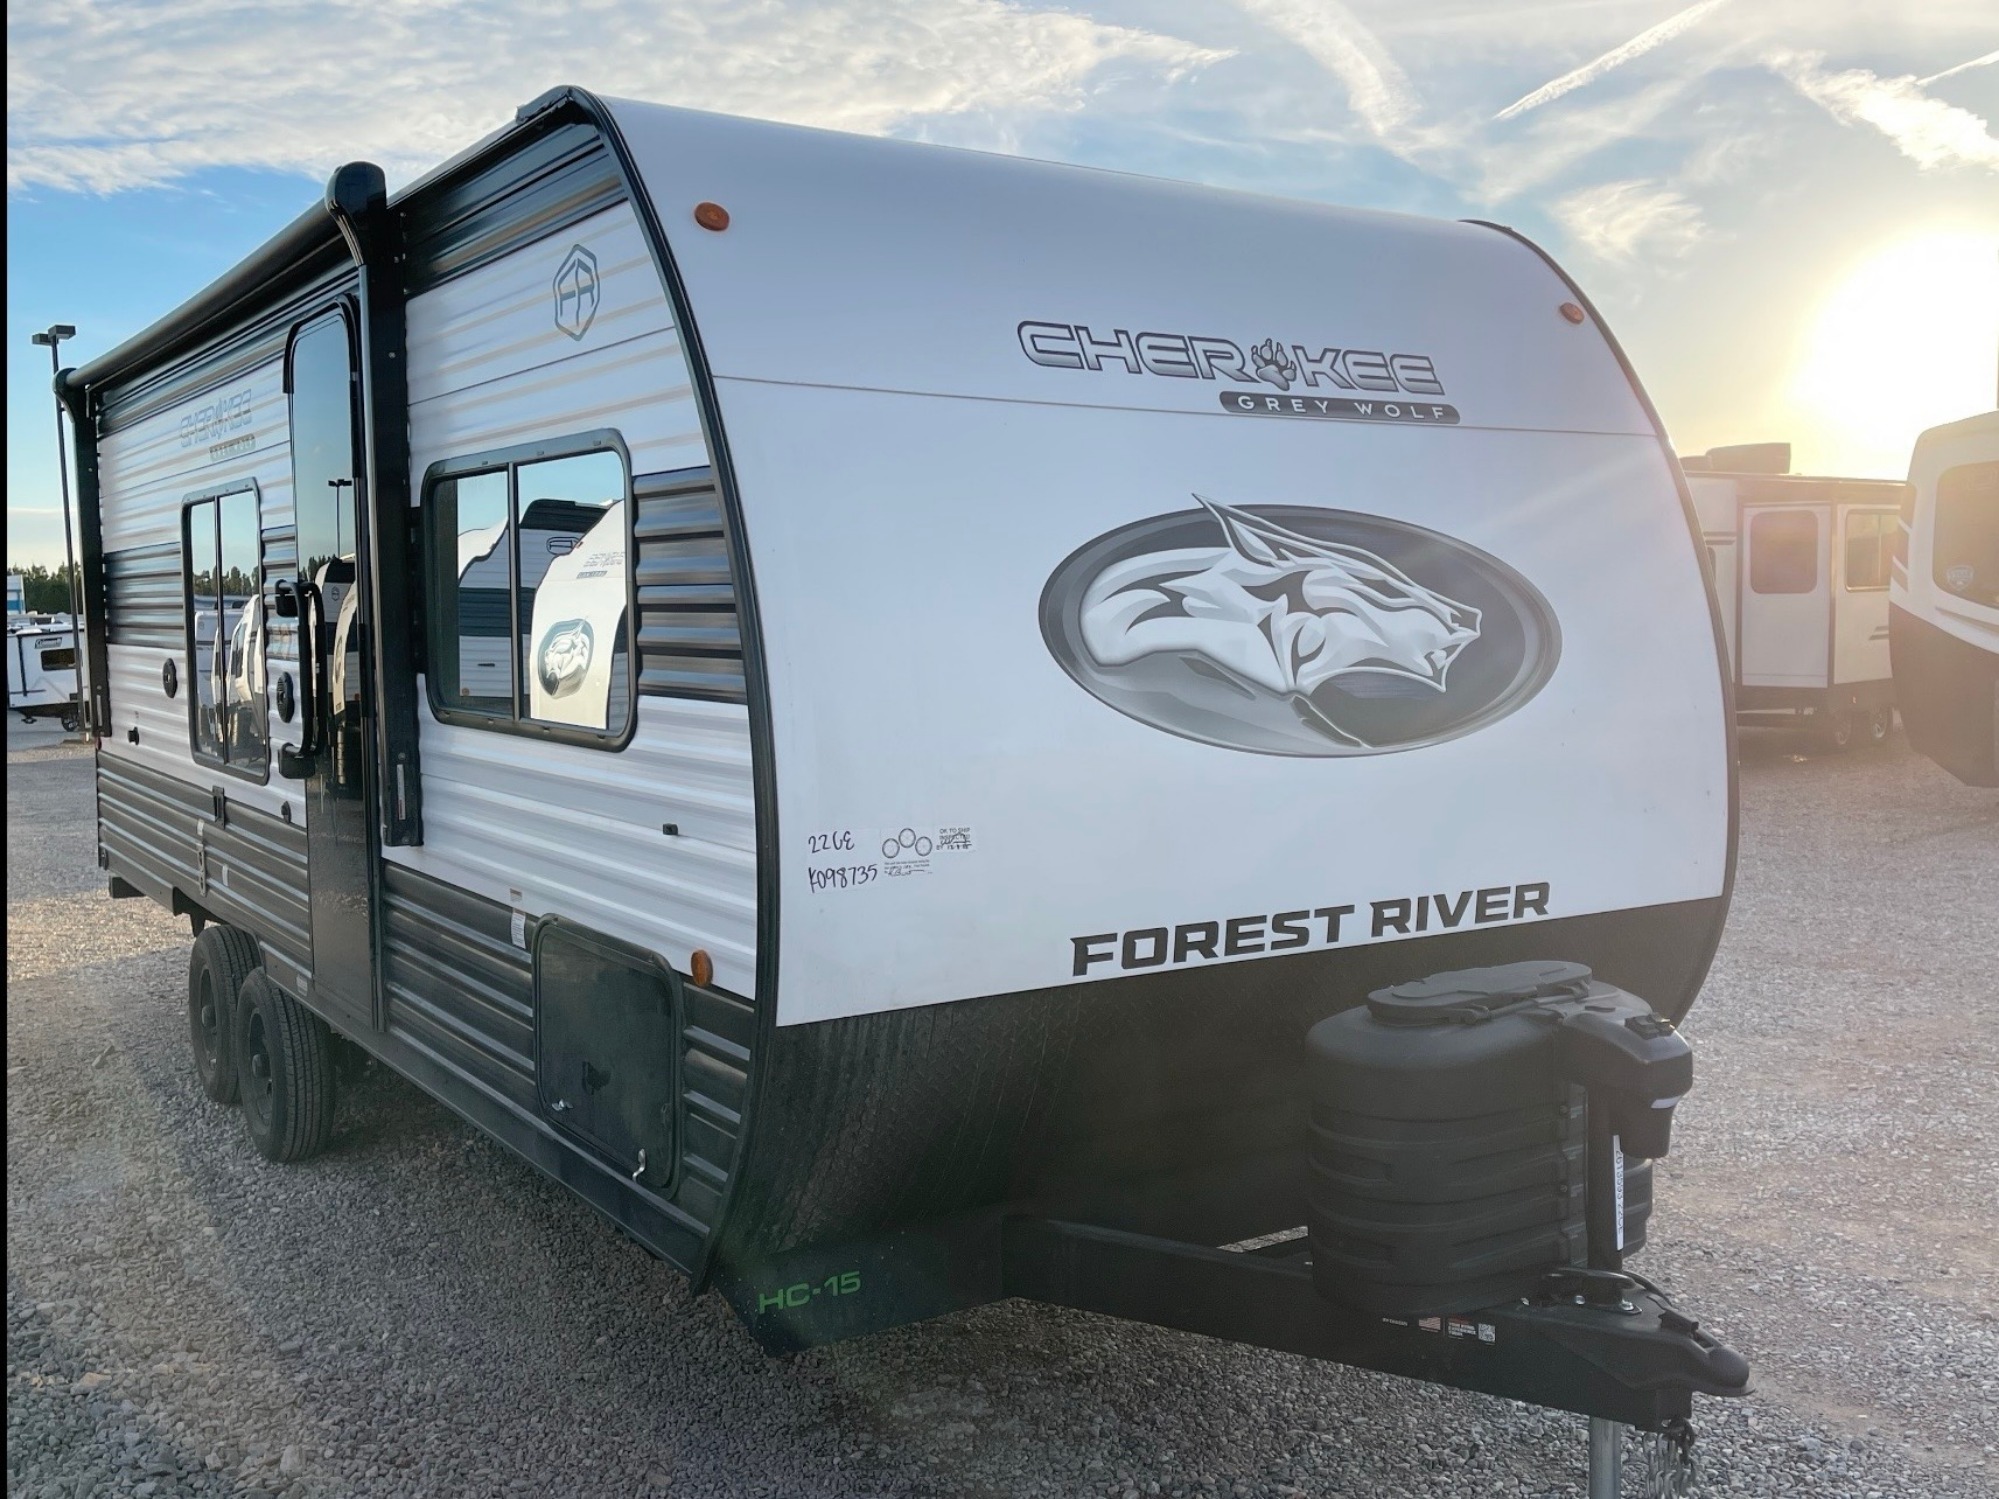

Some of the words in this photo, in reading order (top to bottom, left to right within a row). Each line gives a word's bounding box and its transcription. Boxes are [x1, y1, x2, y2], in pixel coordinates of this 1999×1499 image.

[1237, 395, 1329, 414] GREY
[1353, 402, 1446, 420] WOLF
[1070, 904, 1356, 977] FOREST
[1369, 881, 1551, 938] RIVER
[759, 1270, 861, 1315] HC-15
